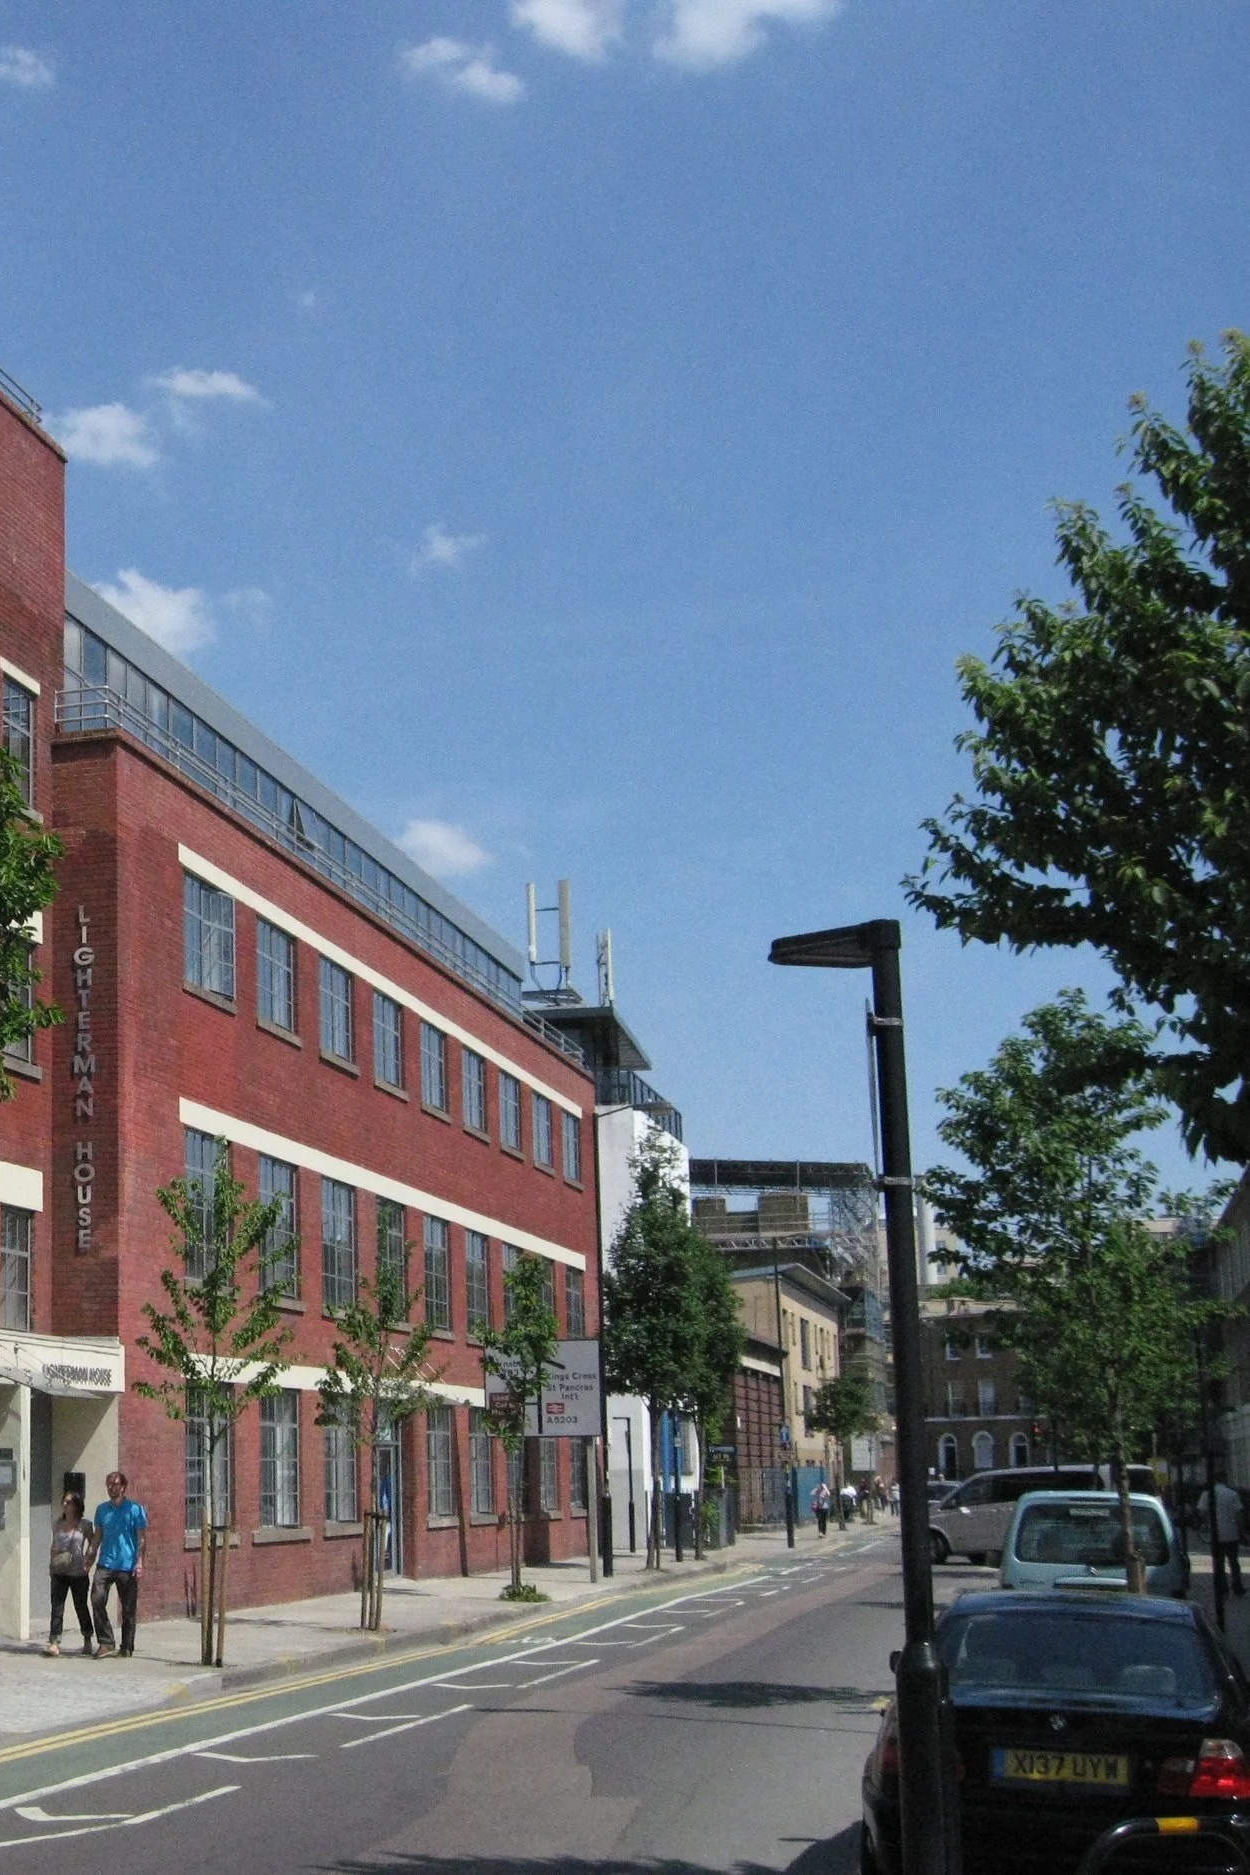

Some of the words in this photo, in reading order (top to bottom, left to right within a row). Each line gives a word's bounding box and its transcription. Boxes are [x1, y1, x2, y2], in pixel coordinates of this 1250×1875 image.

[73, 905, 96, 1117] LIGHTERMAN
[73, 1141, 96, 1250] HOUSE
[559, 1384, 594, 1392] Pancras
[546, 1416, 578, 1424] A5203
